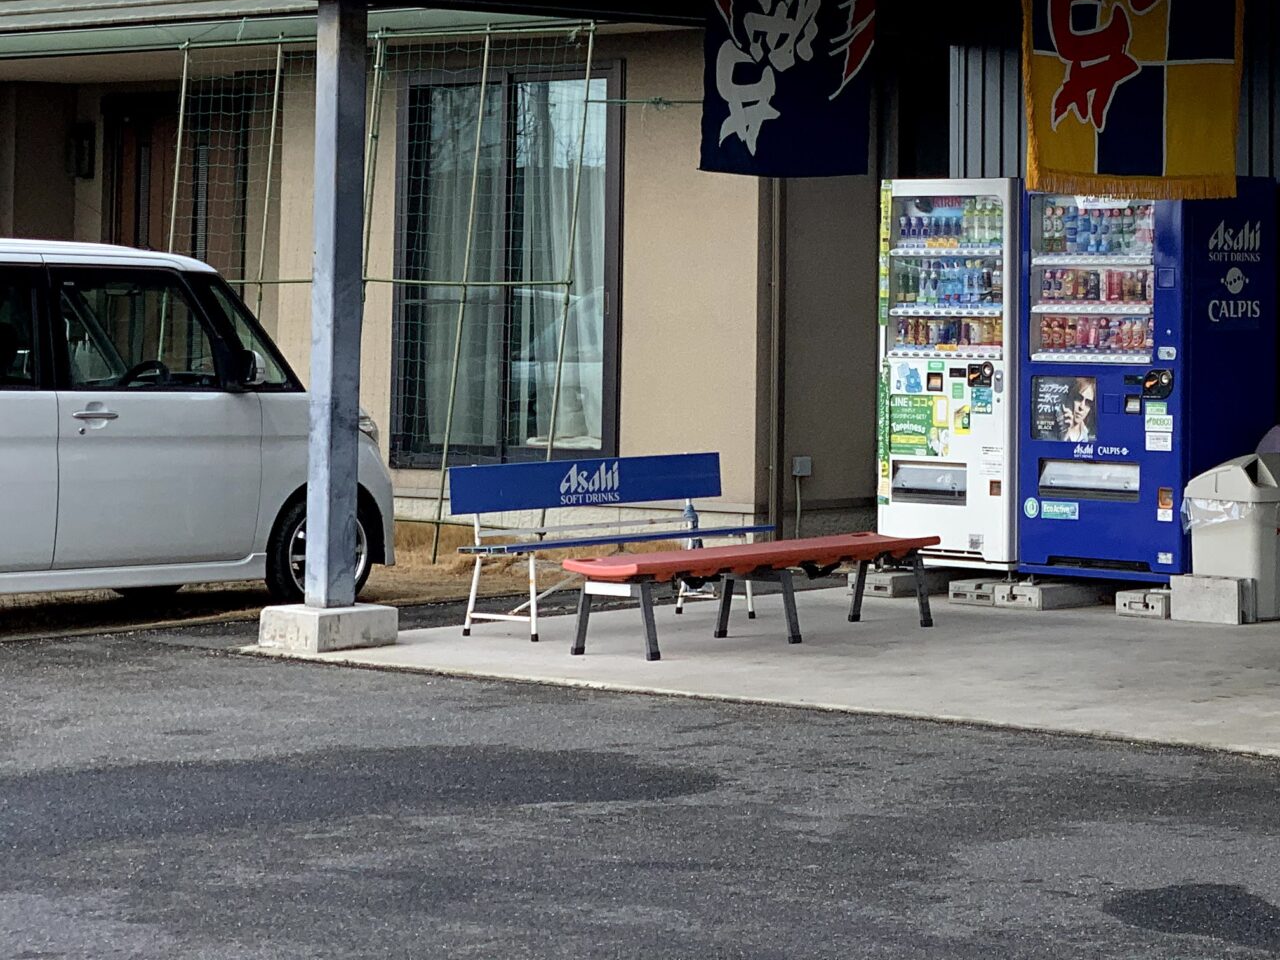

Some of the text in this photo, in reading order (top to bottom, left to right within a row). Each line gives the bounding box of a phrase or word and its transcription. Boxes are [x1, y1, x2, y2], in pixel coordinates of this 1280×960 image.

[932, 197, 962, 209] KIRIN
[1208, 220, 1261, 251] Asahi
[1208, 251, 1261, 262] SOFT DRINKS
[1208, 300, 1261, 322] CALPIS
[1073, 443, 1121, 456] Asahi CALPIS
[560, 461, 619, 494] Asahi
[560, 492, 620, 505] SOFT DRINKS
